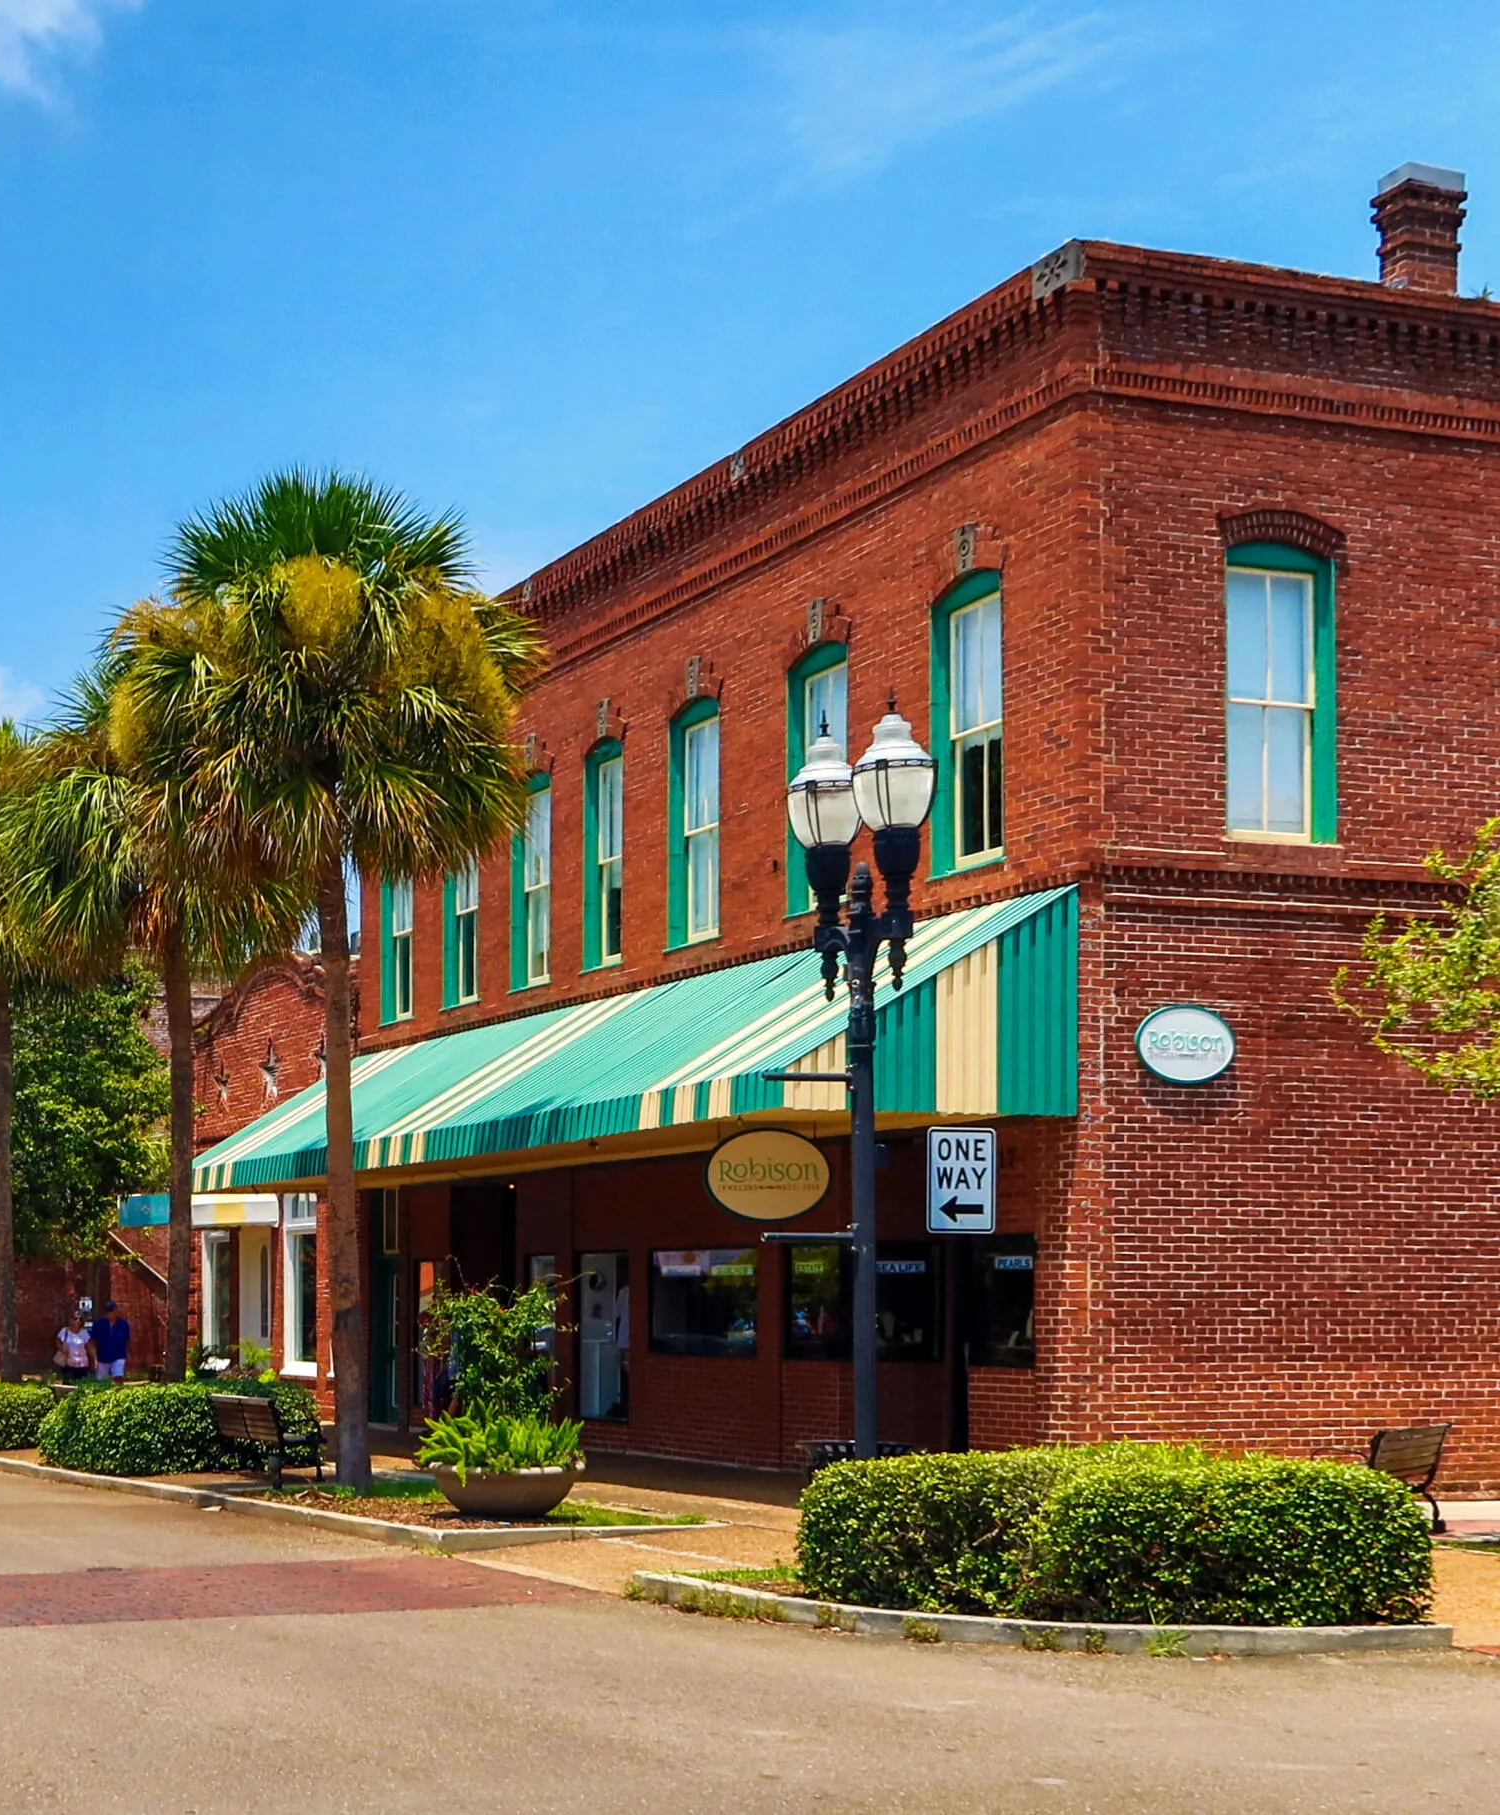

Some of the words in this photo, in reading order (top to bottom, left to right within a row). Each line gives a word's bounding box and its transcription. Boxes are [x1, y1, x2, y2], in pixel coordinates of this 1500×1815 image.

[1147, 1029, 1225, 1051] Robison
[937, 1138, 987, 1161] ONE
[717, 1157, 820, 1182] Robison
[936, 1166, 988, 1190] WAY
[997, 1258, 1030, 1269] PEARLS
